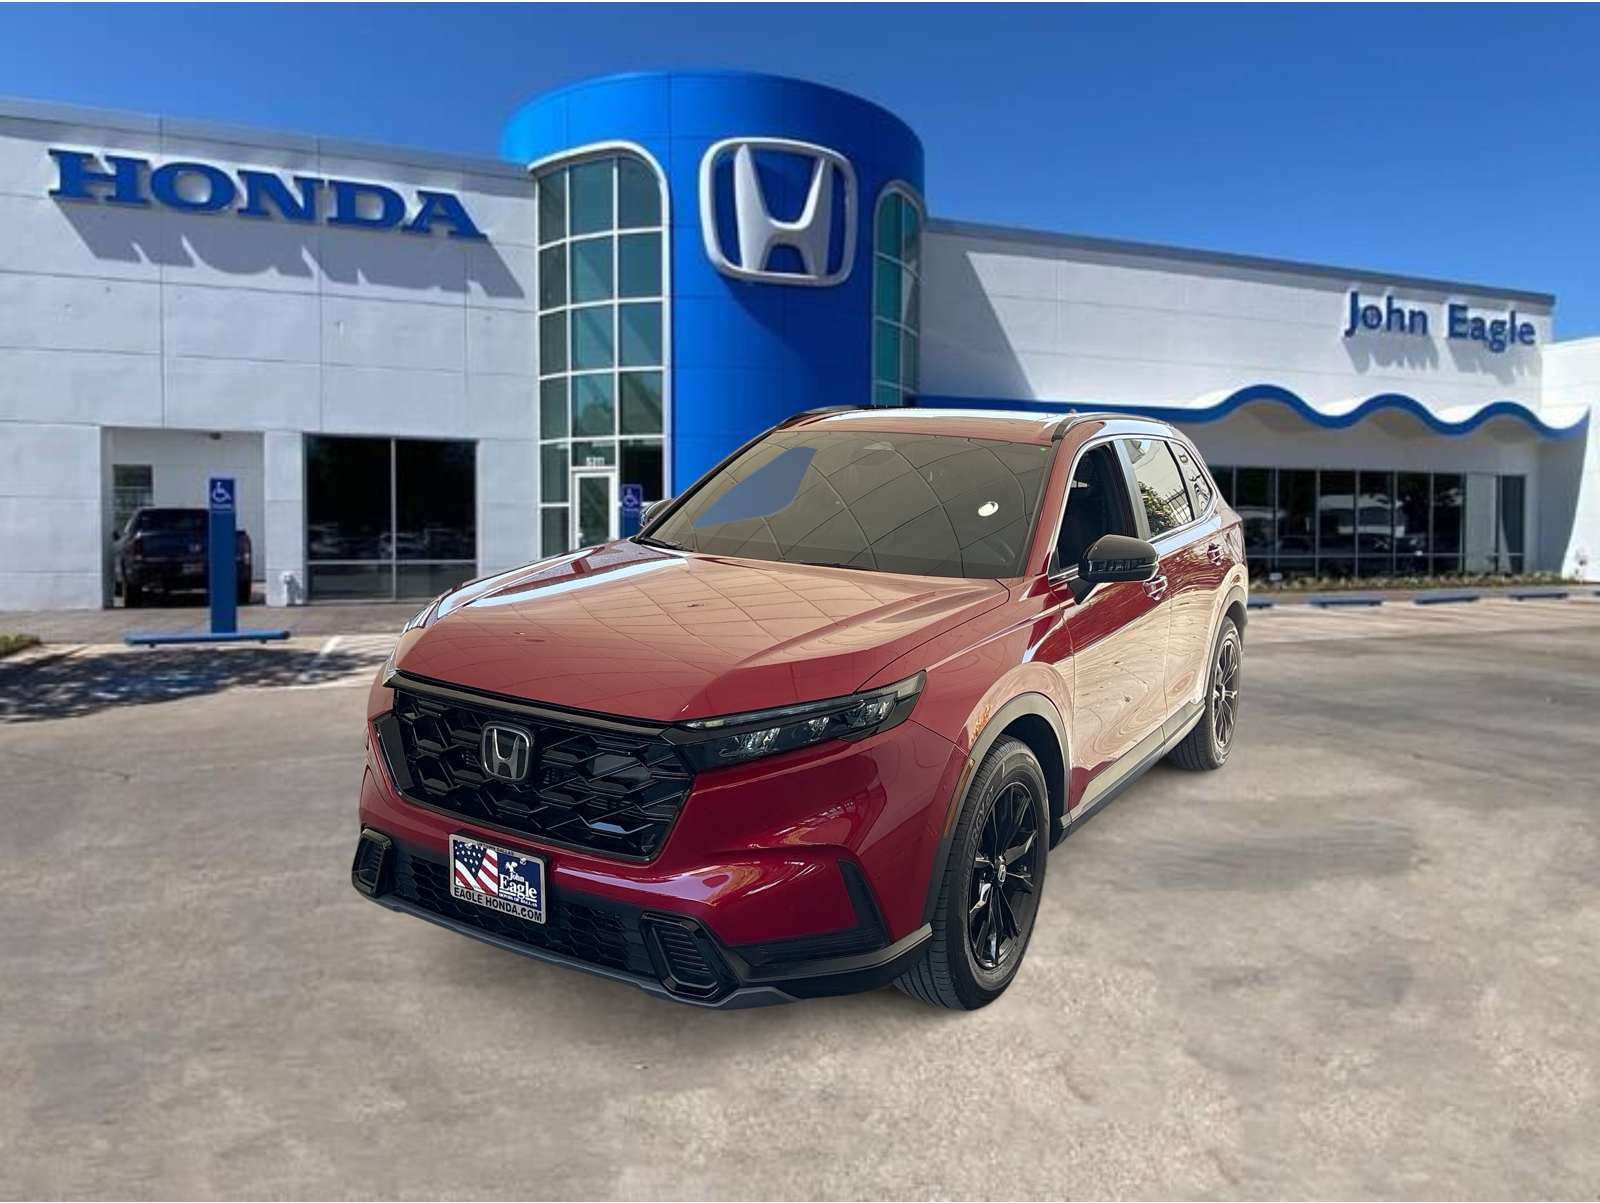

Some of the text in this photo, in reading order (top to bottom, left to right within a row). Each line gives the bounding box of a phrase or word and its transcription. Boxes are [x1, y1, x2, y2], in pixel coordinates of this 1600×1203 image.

[48, 148, 488, 240] HONDA
[1344, 290, 1536, 353] John Eagle
[499, 873, 538, 899] Eagle
[509, 871, 525, 883] John
[454, 887, 542, 922] EAGLE HONDA.COM
